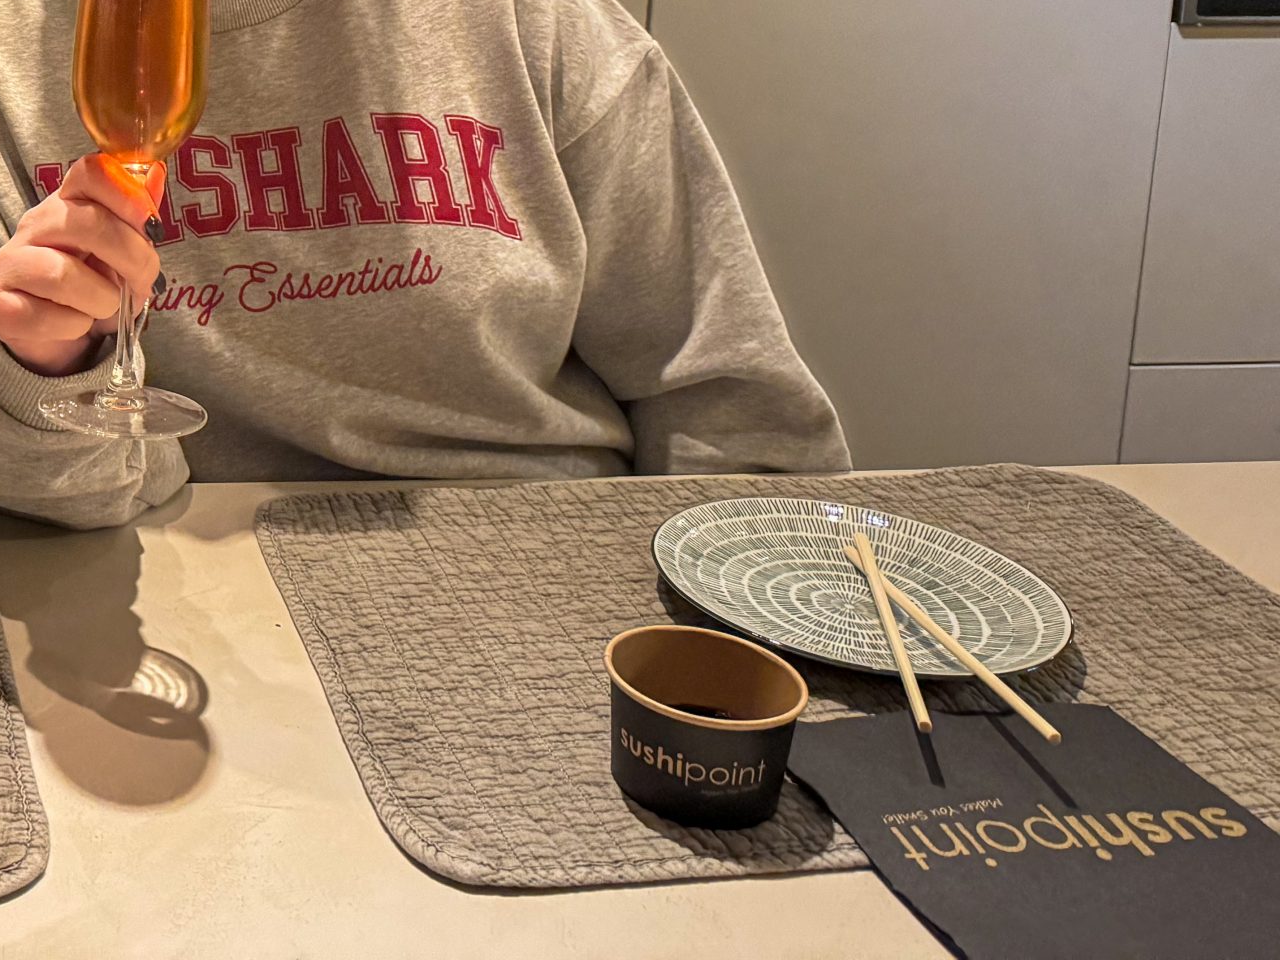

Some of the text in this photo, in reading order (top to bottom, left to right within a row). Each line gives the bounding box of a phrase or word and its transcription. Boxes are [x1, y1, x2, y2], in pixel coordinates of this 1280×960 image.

[35, 113, 522, 248] SHARK
[223, 248, 443, 313] Essentials
[620, 727, 766, 787] sushipoint
[889, 804, 1249, 871] sushipoint
[929, 805, 959, 817] You
